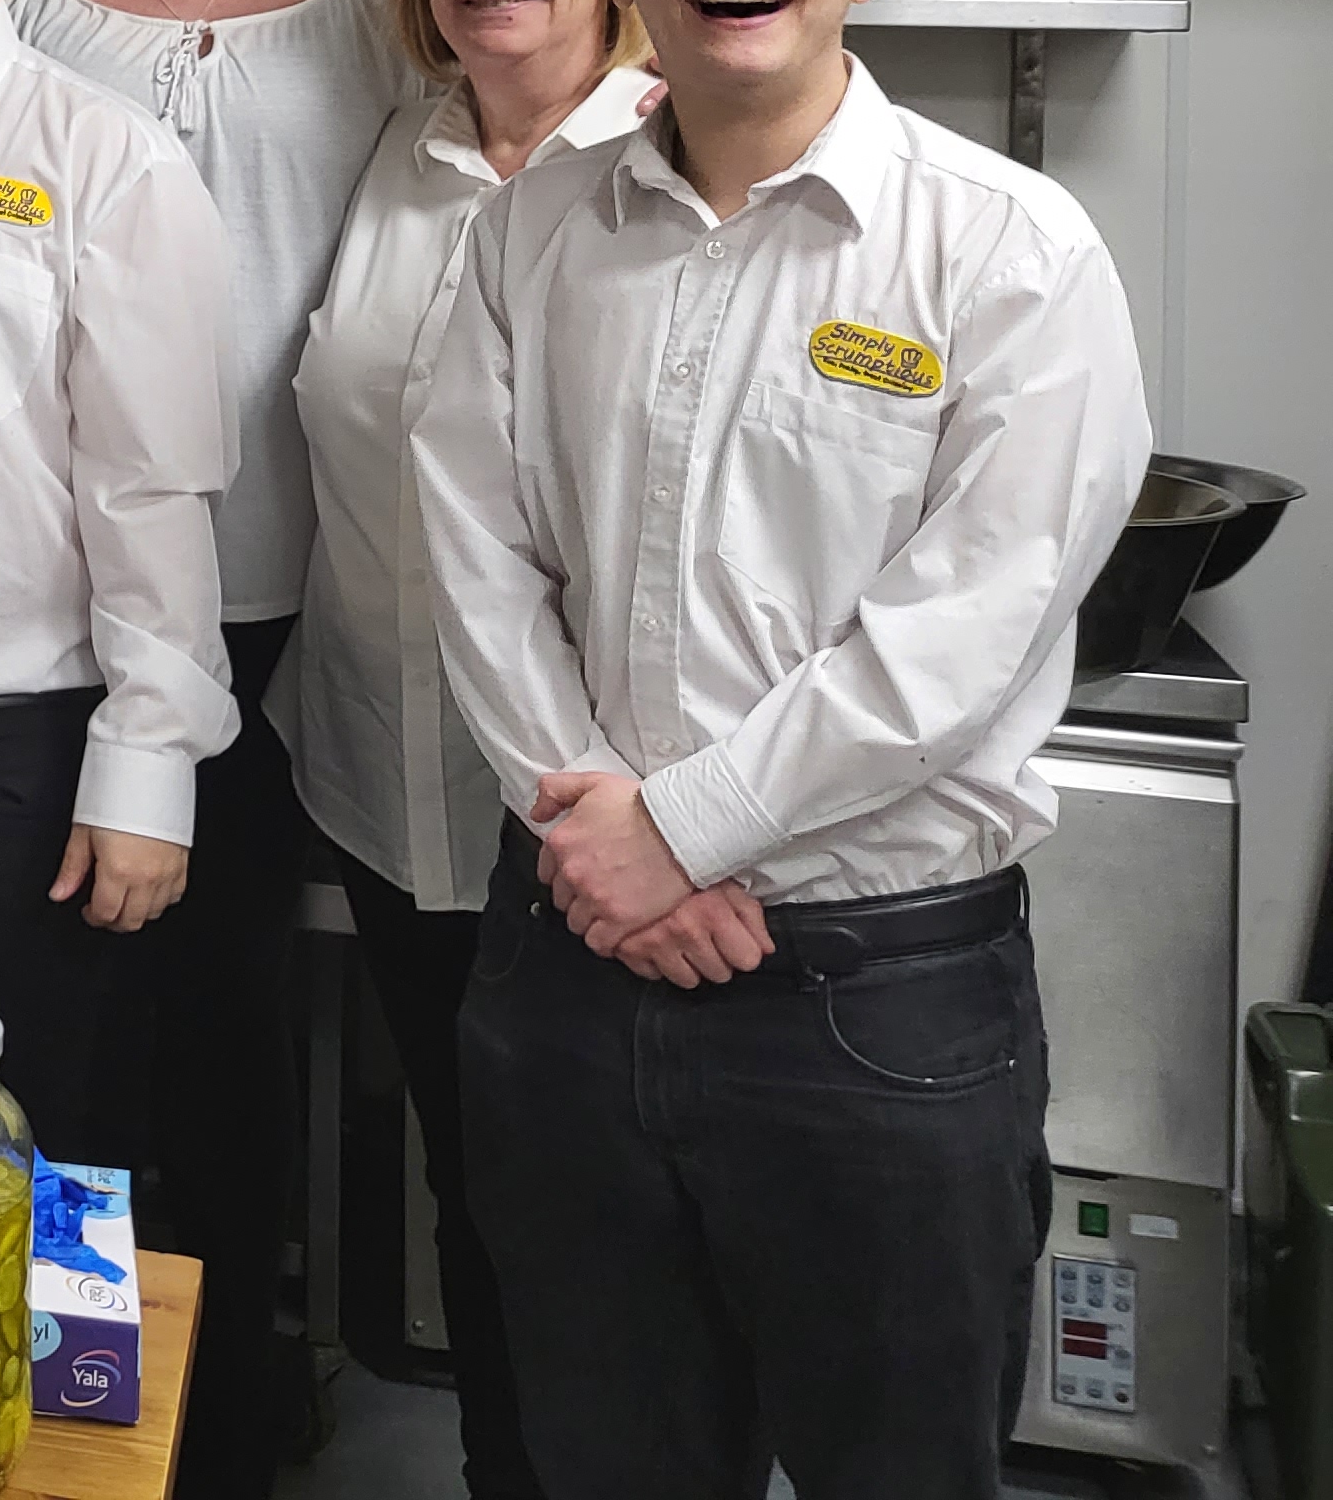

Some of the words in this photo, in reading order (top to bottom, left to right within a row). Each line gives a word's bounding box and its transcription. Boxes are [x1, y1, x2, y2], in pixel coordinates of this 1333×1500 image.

[830, 323, 895, 357] Simply
[813, 336, 934, 387] Scrumptious
[34, 1323, 49, 1343] yl
[72, 1367, 109, 1389] Yala
